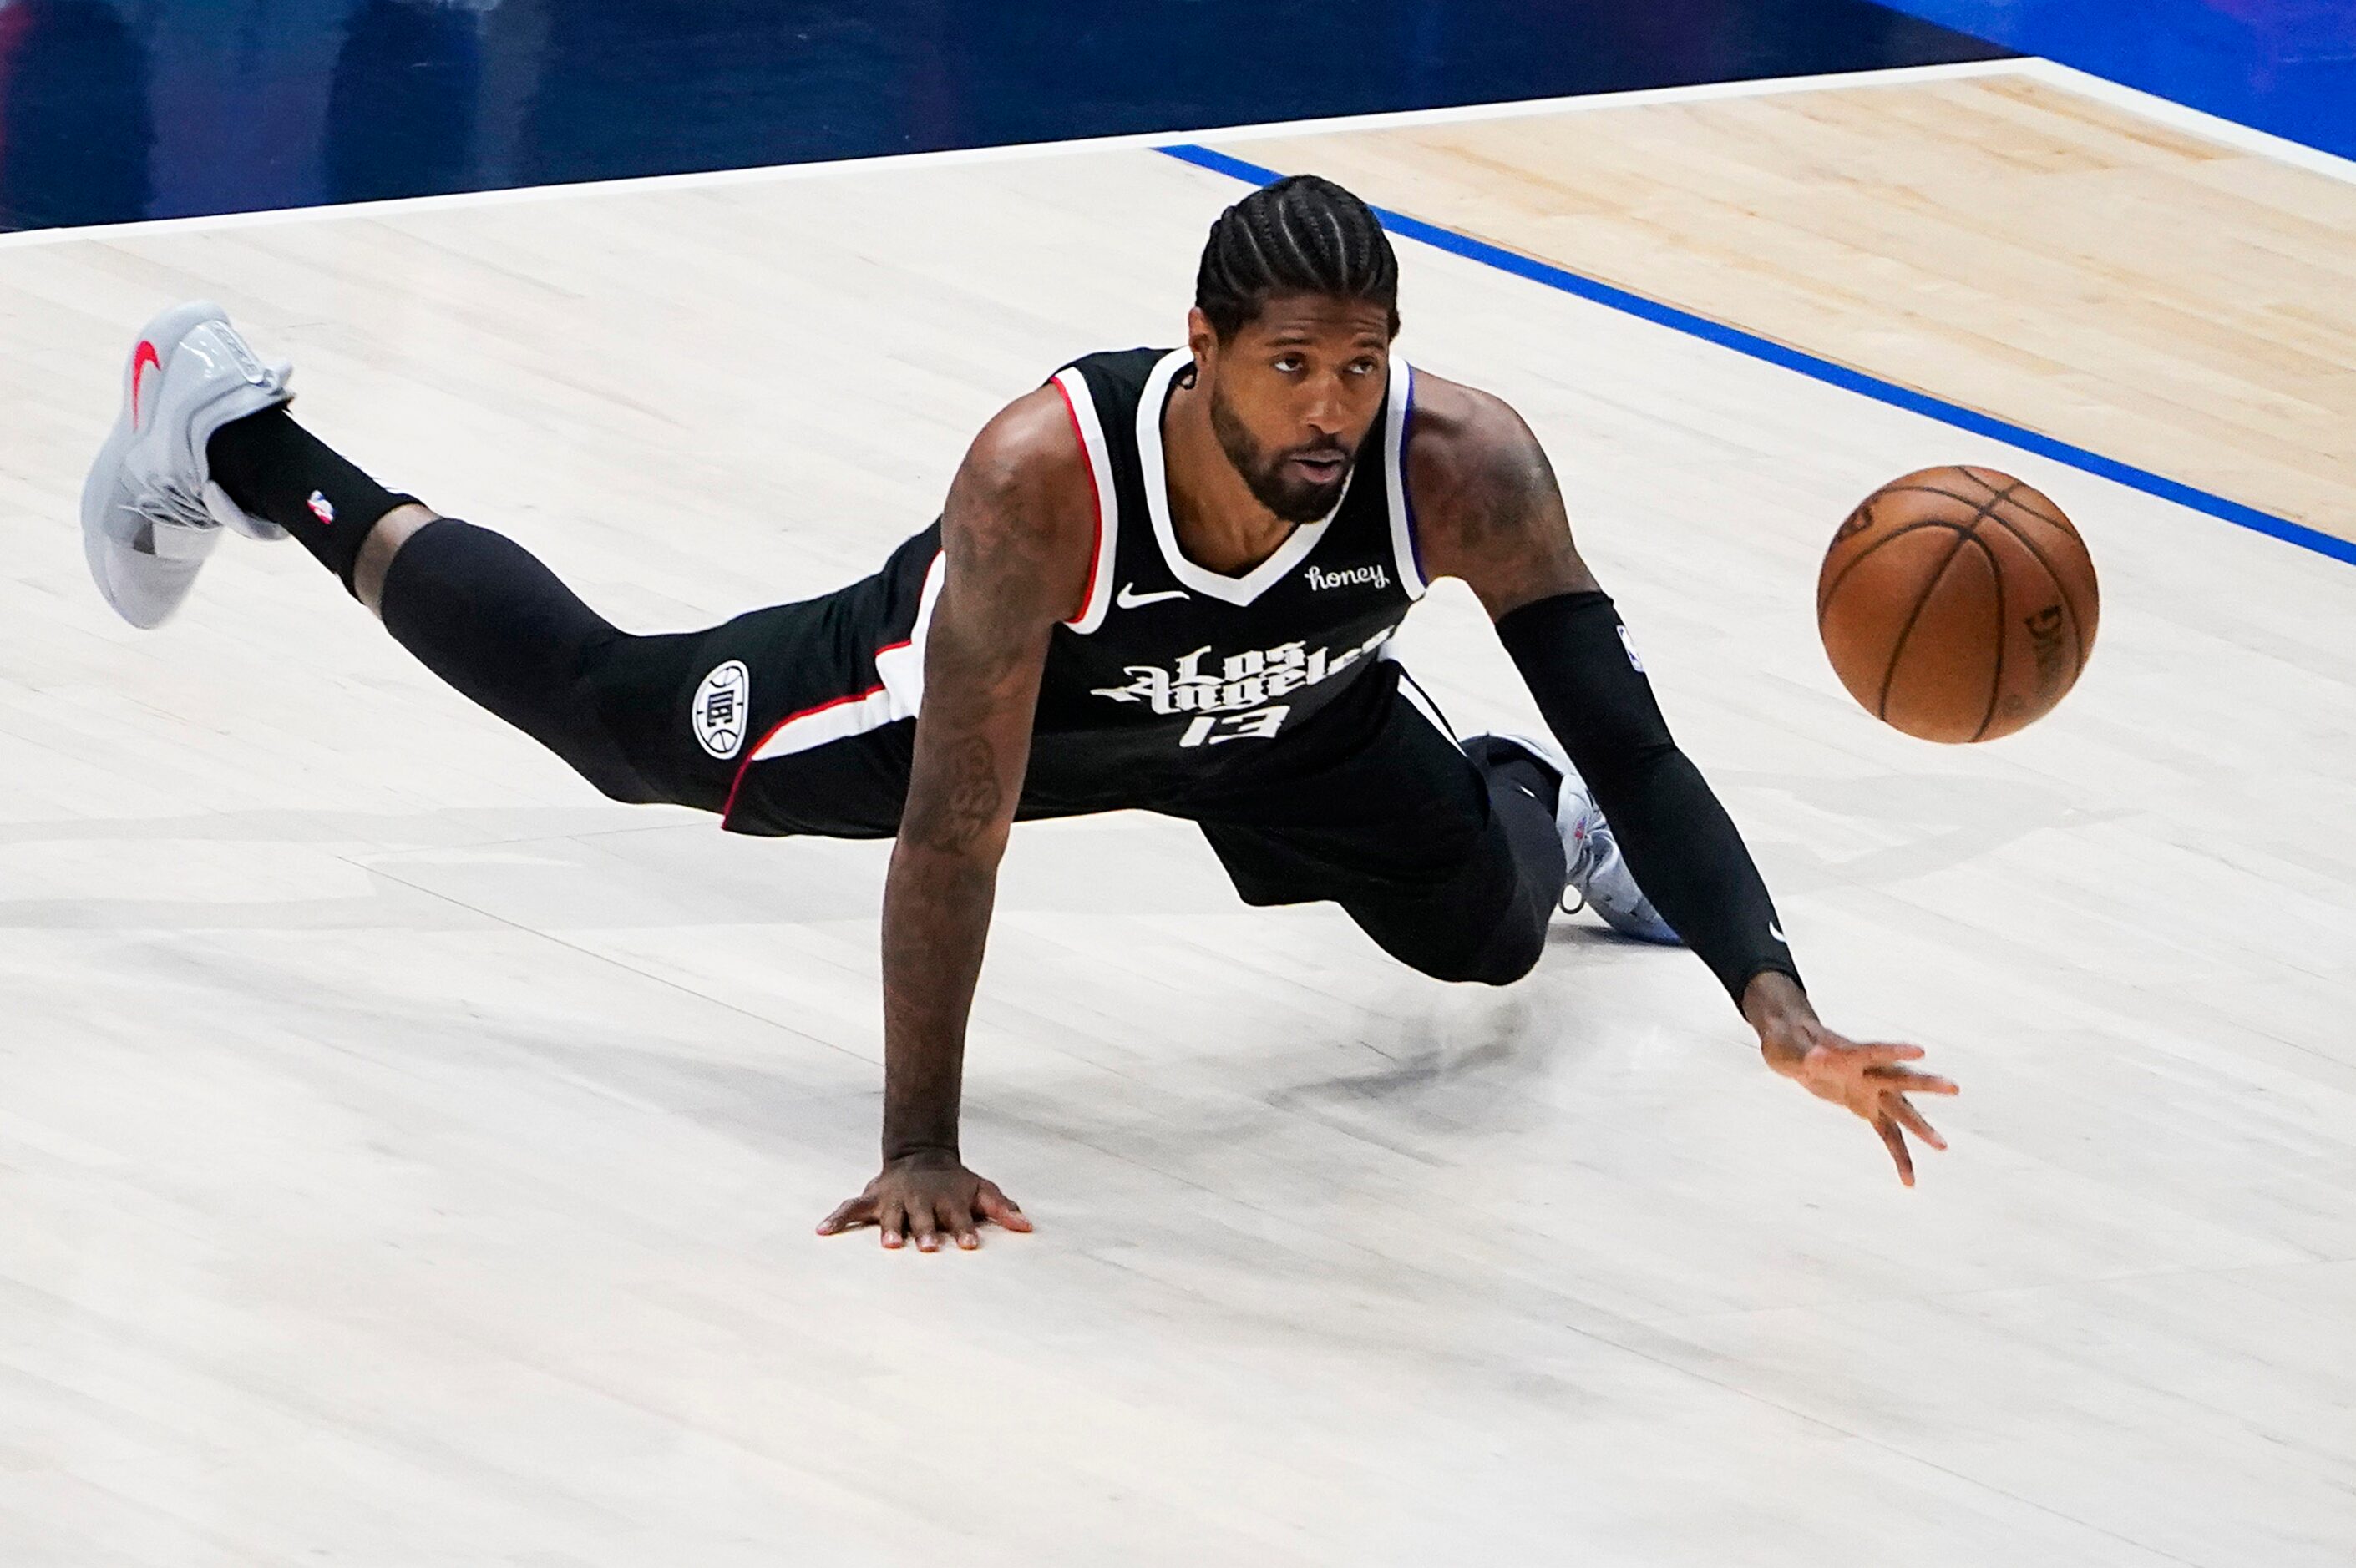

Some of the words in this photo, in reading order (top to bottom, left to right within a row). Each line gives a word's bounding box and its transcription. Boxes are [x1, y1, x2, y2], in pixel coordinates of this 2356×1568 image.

[1304, 564, 1390, 591] honey
[1170, 640, 1306, 686] Los
[1179, 706, 1290, 747] 13
